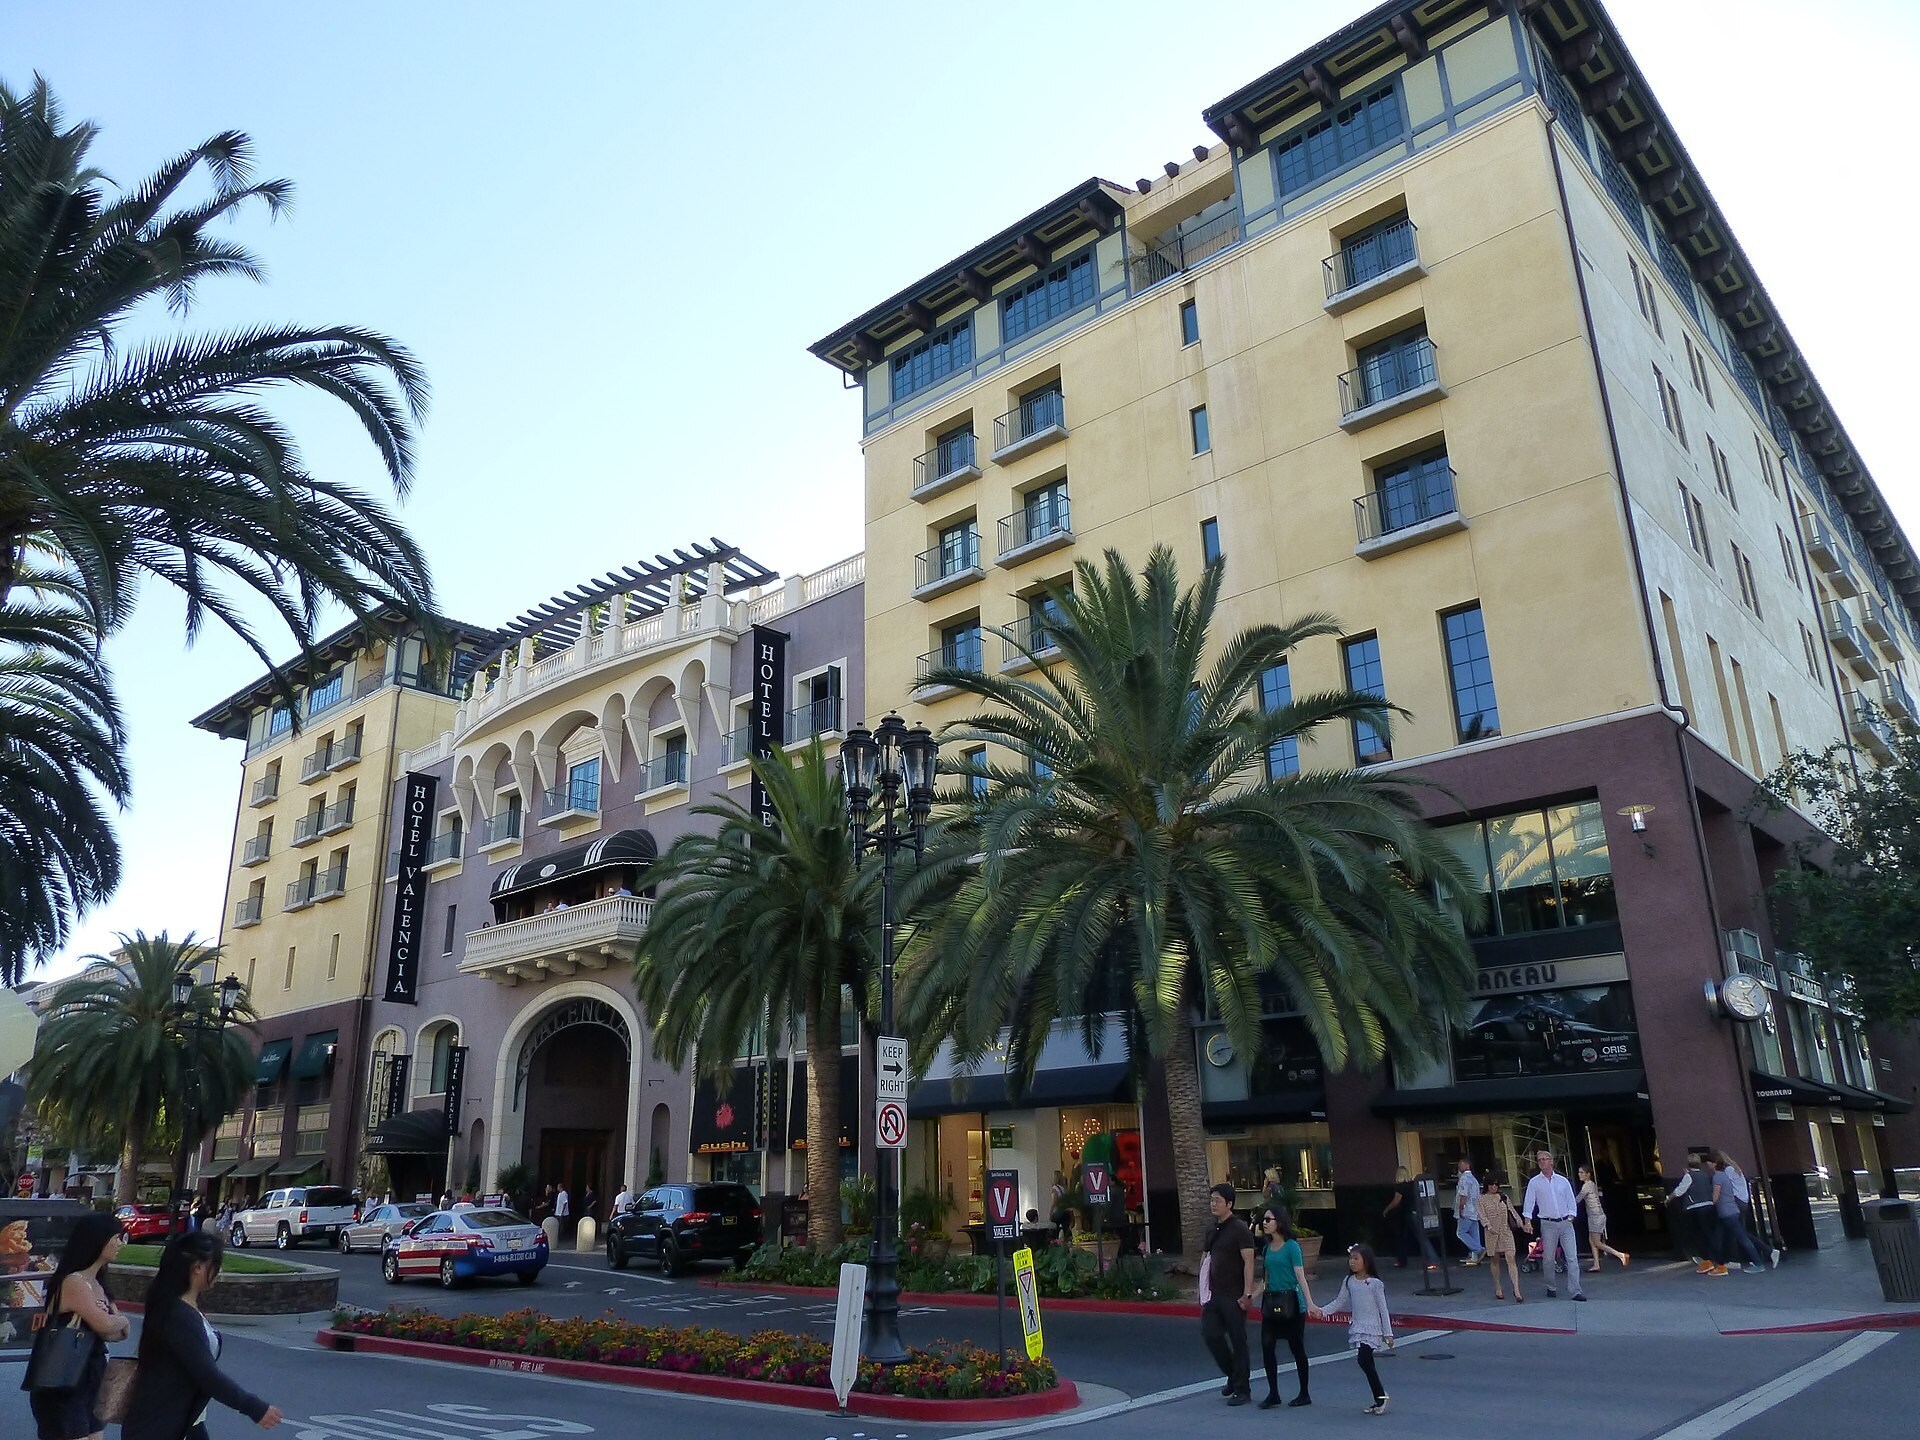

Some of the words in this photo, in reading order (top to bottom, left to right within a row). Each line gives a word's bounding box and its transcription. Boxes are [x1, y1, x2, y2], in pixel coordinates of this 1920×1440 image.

[761, 644, 774, 737] HOTEL
[409, 785, 427, 857] HOTEL
[393, 866, 417, 993] VALENCIA
[1478, 964, 1556, 990] RNEAU
[882, 1046, 904, 1058] KEEP
[1602, 1045, 1627, 1055] ORIS
[371, 1060, 381, 1124] CITRUS
[880, 1079, 905, 1092] RIGHT
[700, 1140, 747, 1149] sushi
[19, 1177, 35, 1186] STOP
[1089, 1171, 1103, 1190] V
[993, 1187, 1011, 1218] V
[993, 1227, 1013, 1236] VALET
[520, 1361, 531, 1372] FIRE
